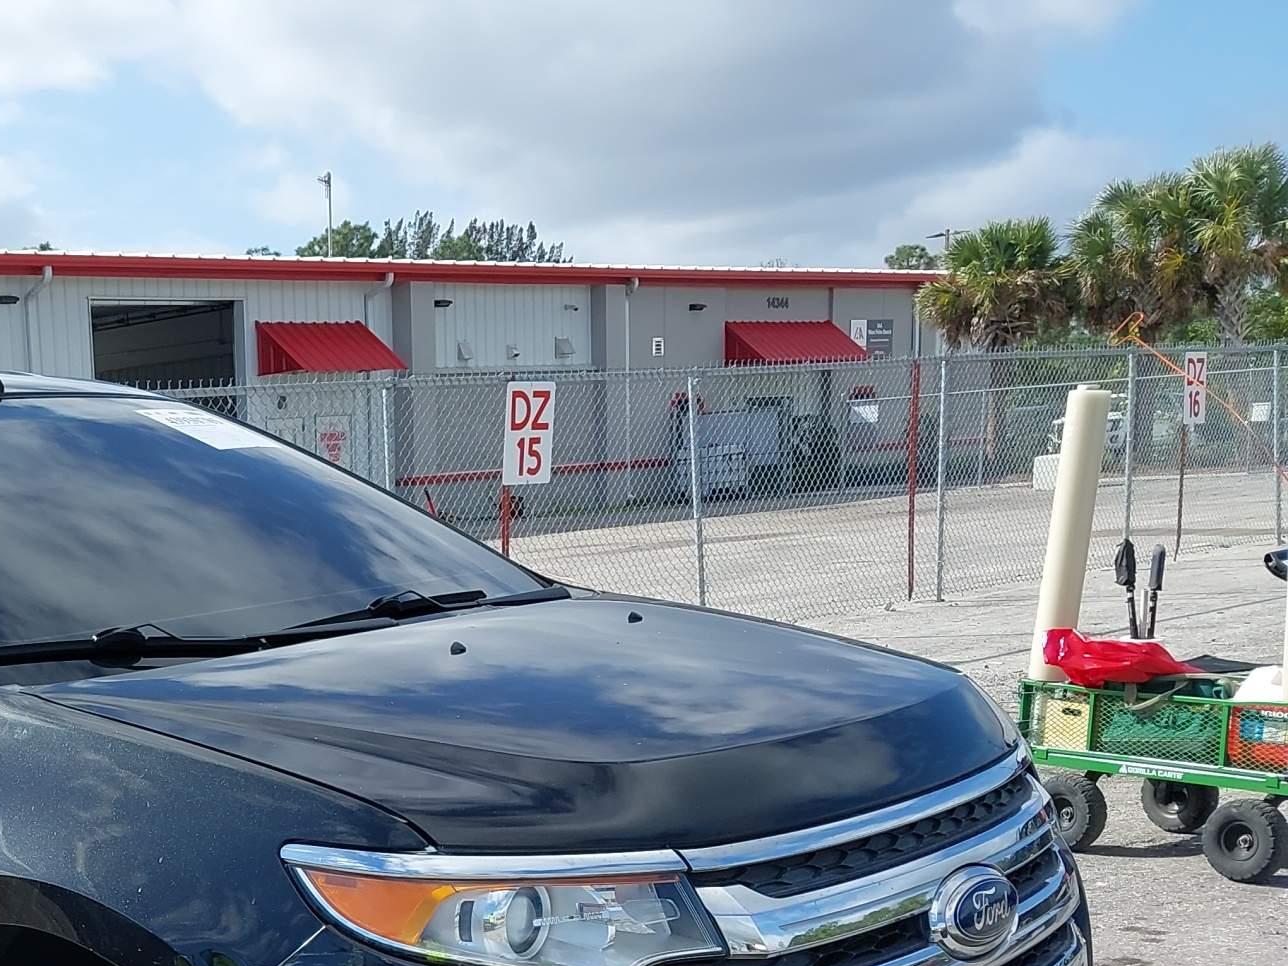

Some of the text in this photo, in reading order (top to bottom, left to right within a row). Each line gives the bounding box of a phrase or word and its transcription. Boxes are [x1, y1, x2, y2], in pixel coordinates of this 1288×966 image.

[766, 296, 789, 309] 14344
[1187, 357, 1205, 386] DZ
[510, 390, 551, 431] DZ
[1188, 390, 1200, 418] 16
[517, 436, 542, 477] 15
[972, 886, 1011, 931] Ford
